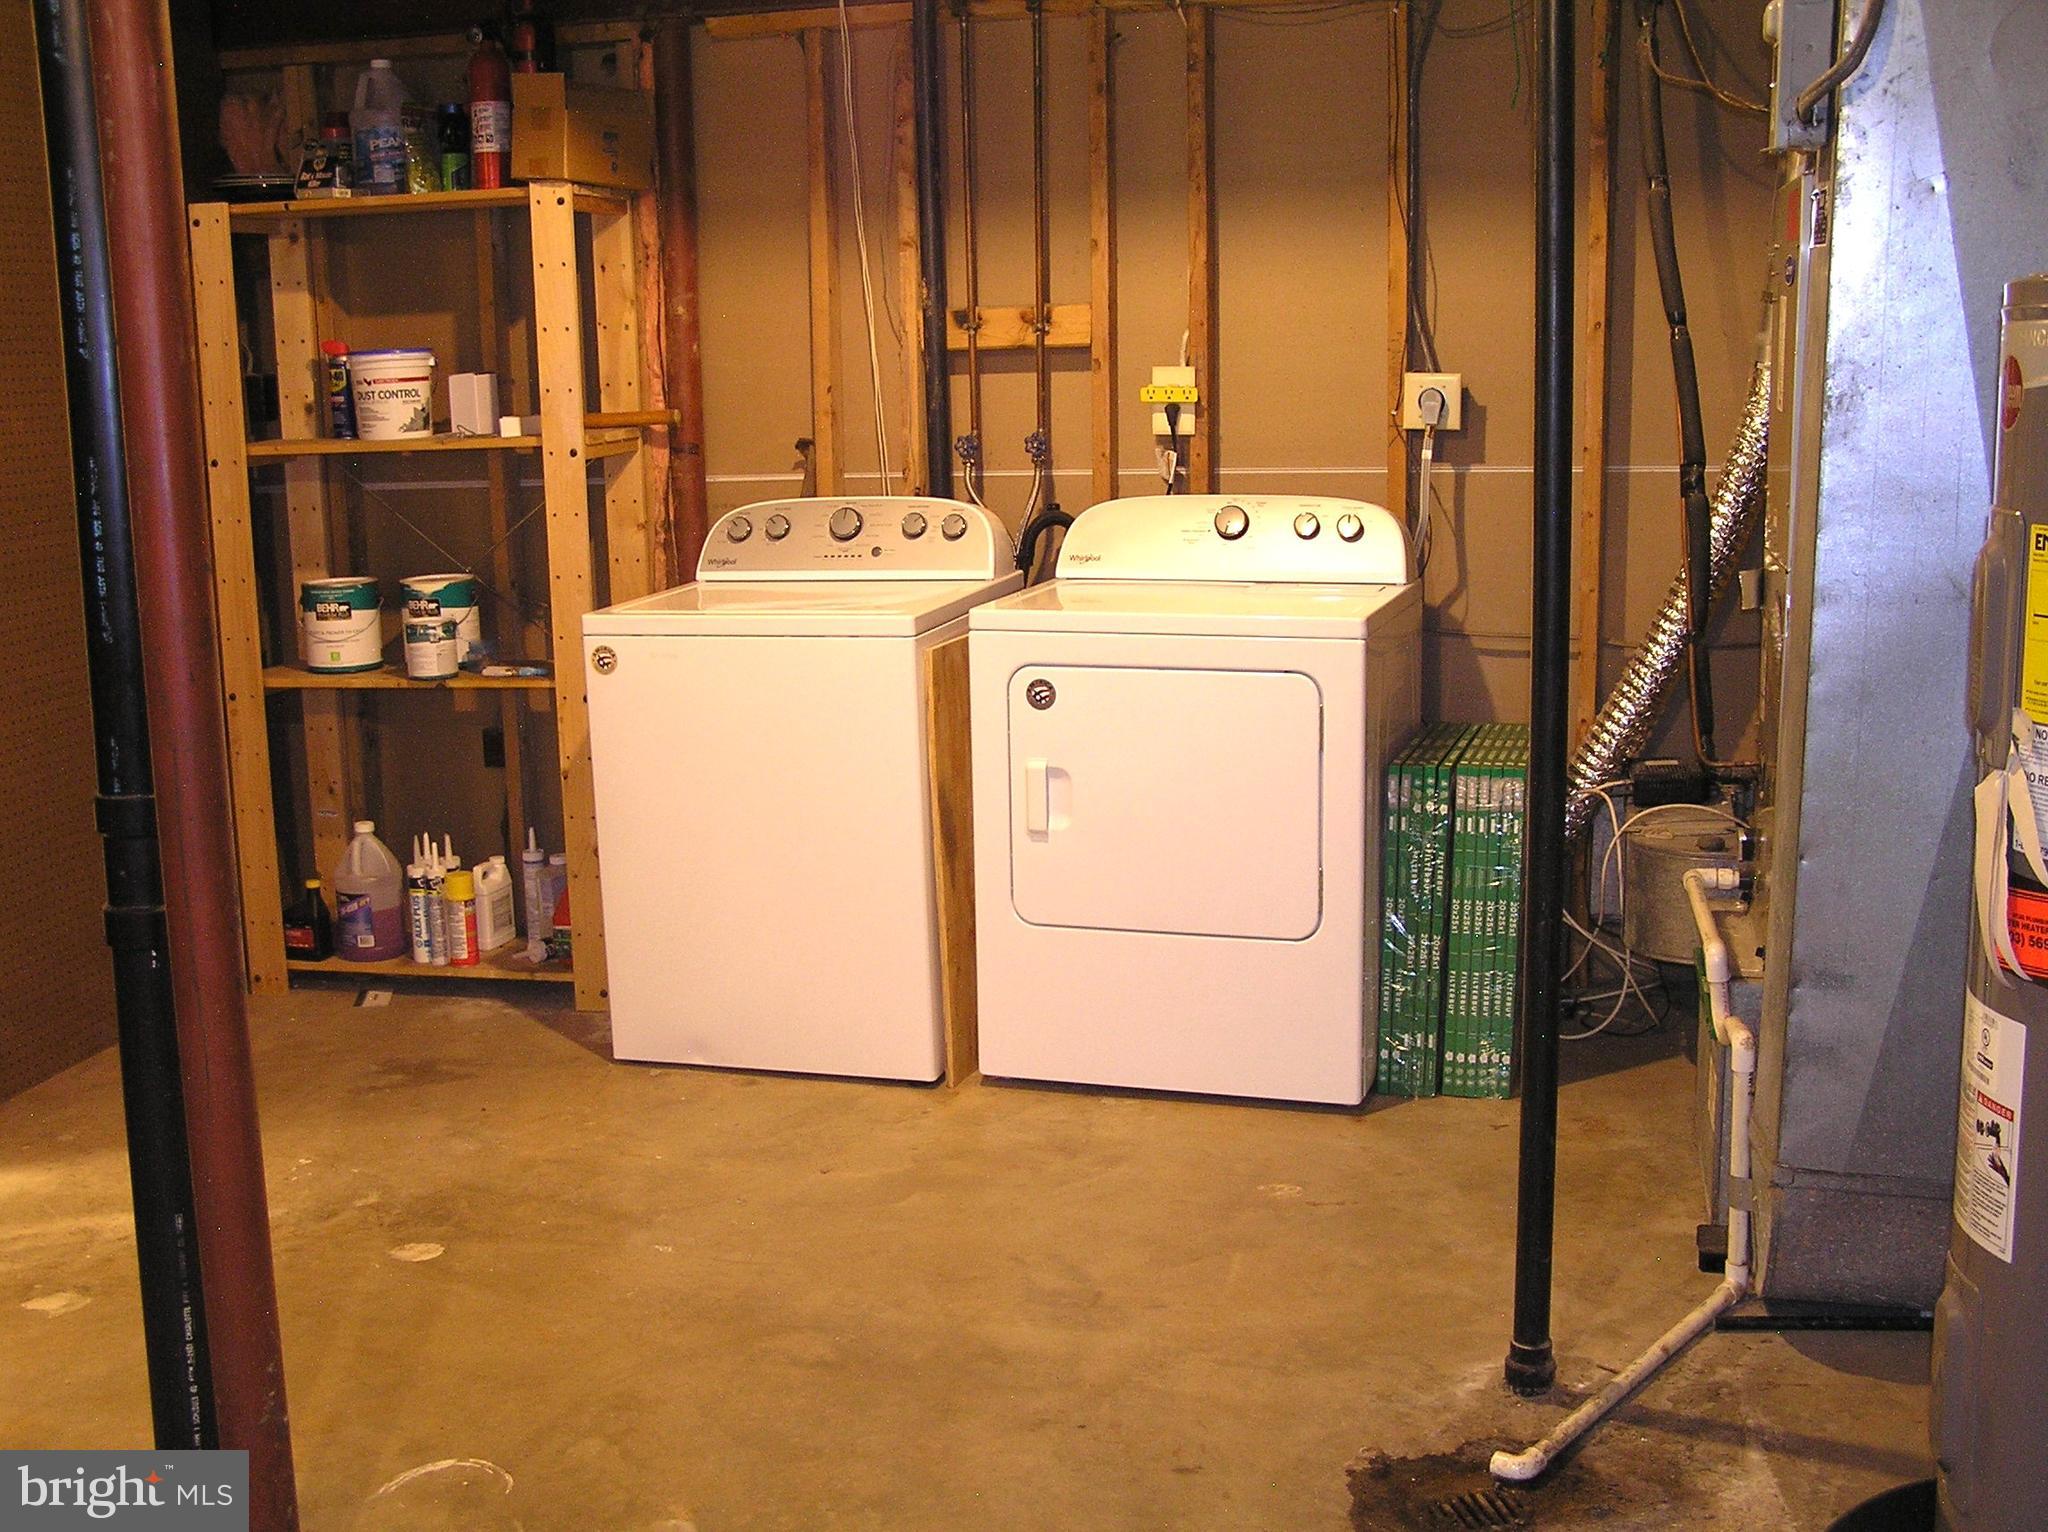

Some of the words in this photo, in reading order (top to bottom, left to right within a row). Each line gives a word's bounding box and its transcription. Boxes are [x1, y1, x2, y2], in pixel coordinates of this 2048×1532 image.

[369, 136, 402, 151] PEA
[378, 387, 421, 400] CONTROL
[707, 557, 737, 568] Whirlpool
[1069, 553, 1101, 565] Whirlpool
[316, 603, 339, 612] BEHR
[1437, 851, 1445, 897] FILTERBUY
[1475, 900, 1483, 935] 20x25x1
[1486, 901, 1495, 936] 20x25x1
[1471, 972, 1479, 1017] FILTERBUY
